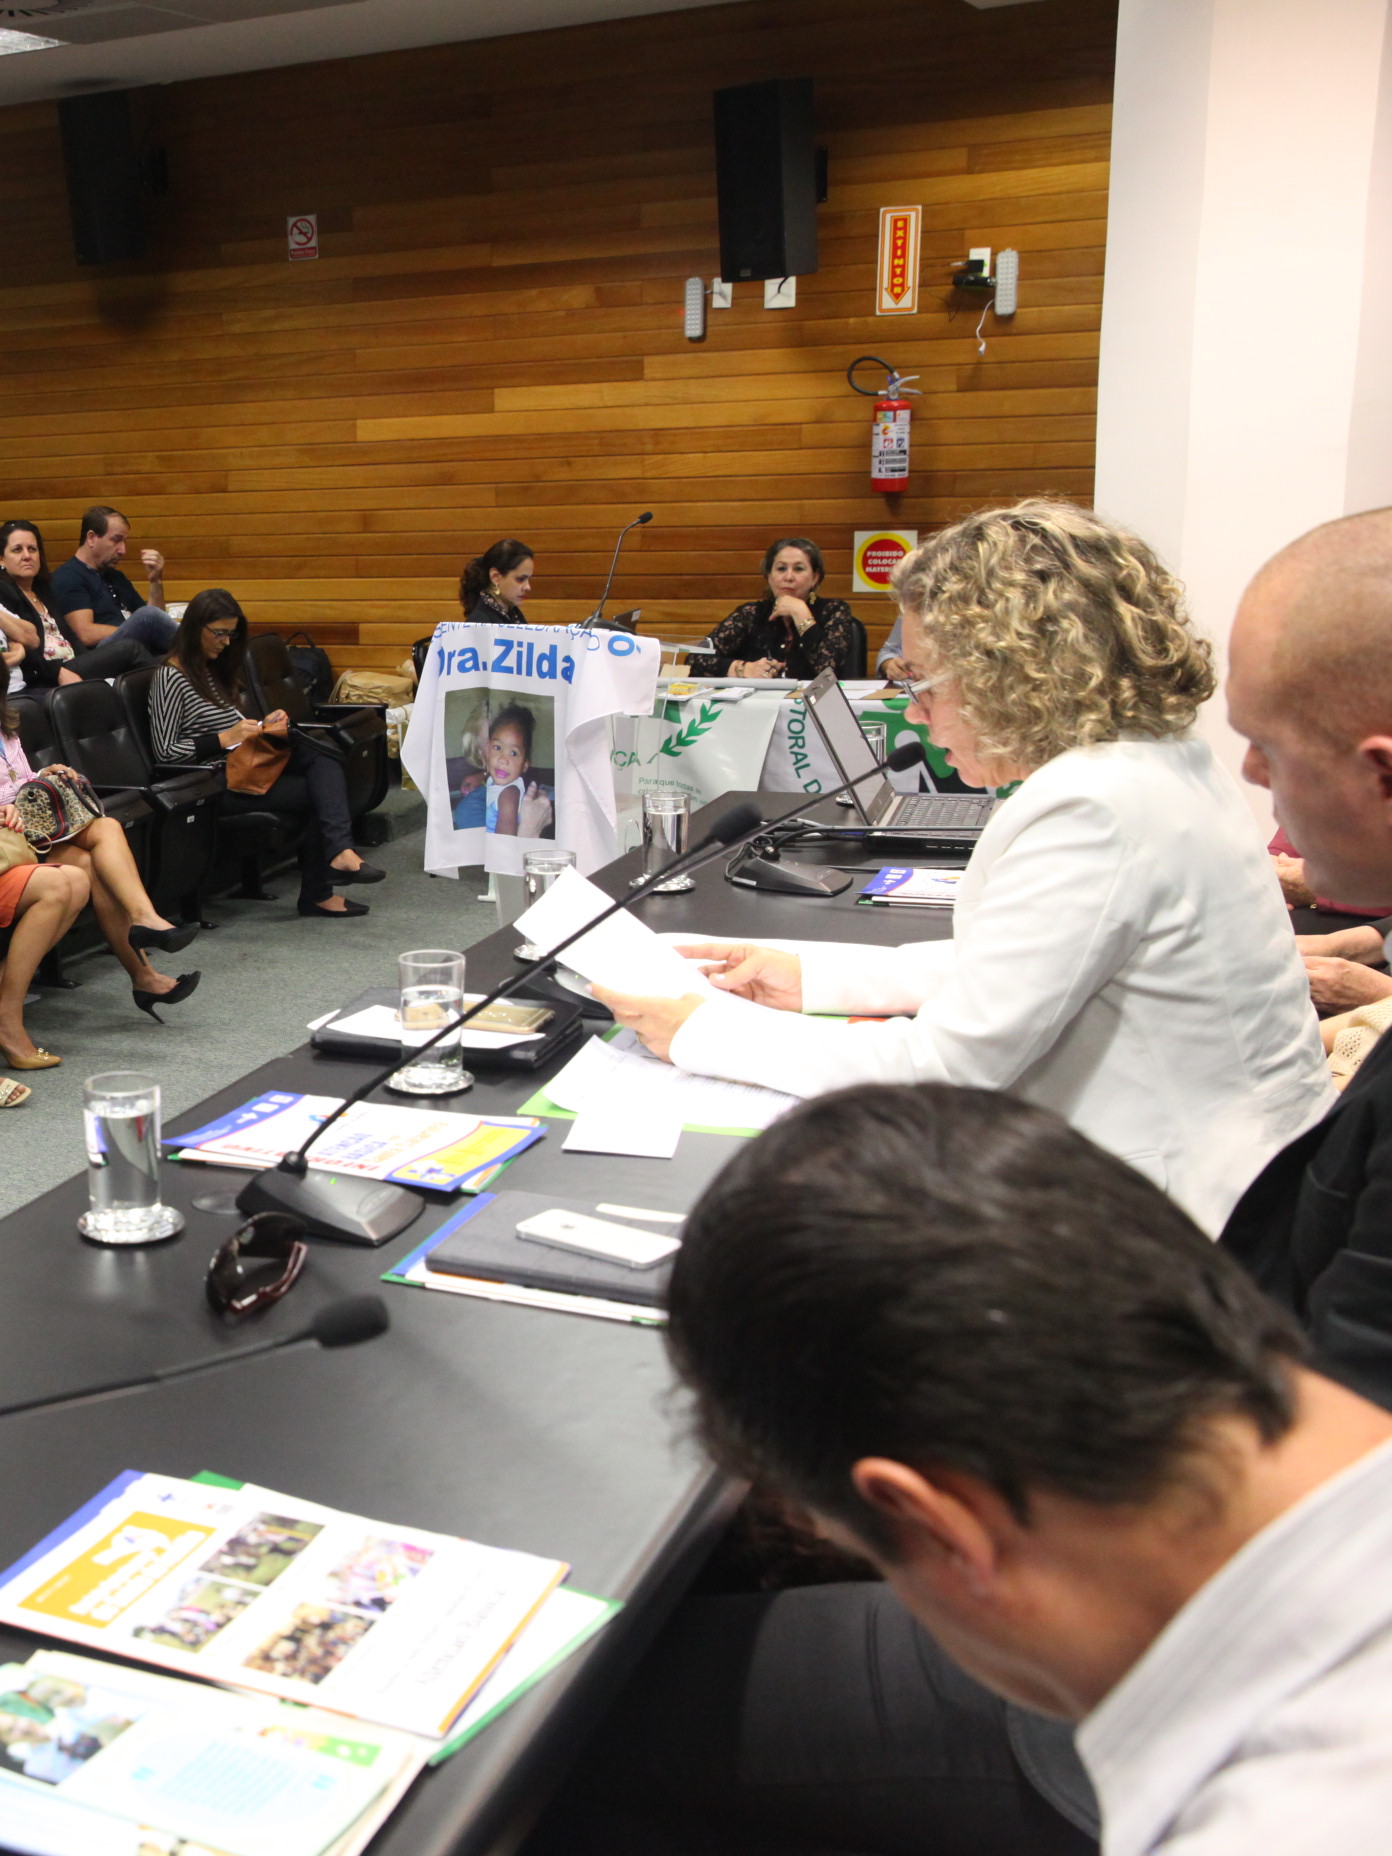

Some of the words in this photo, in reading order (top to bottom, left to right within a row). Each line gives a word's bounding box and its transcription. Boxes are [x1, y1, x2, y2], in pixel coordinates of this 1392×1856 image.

[893, 220, 905, 294] EXTINTOR
[638, 777, 658, 785] Para
[659, 780, 675, 788] que
